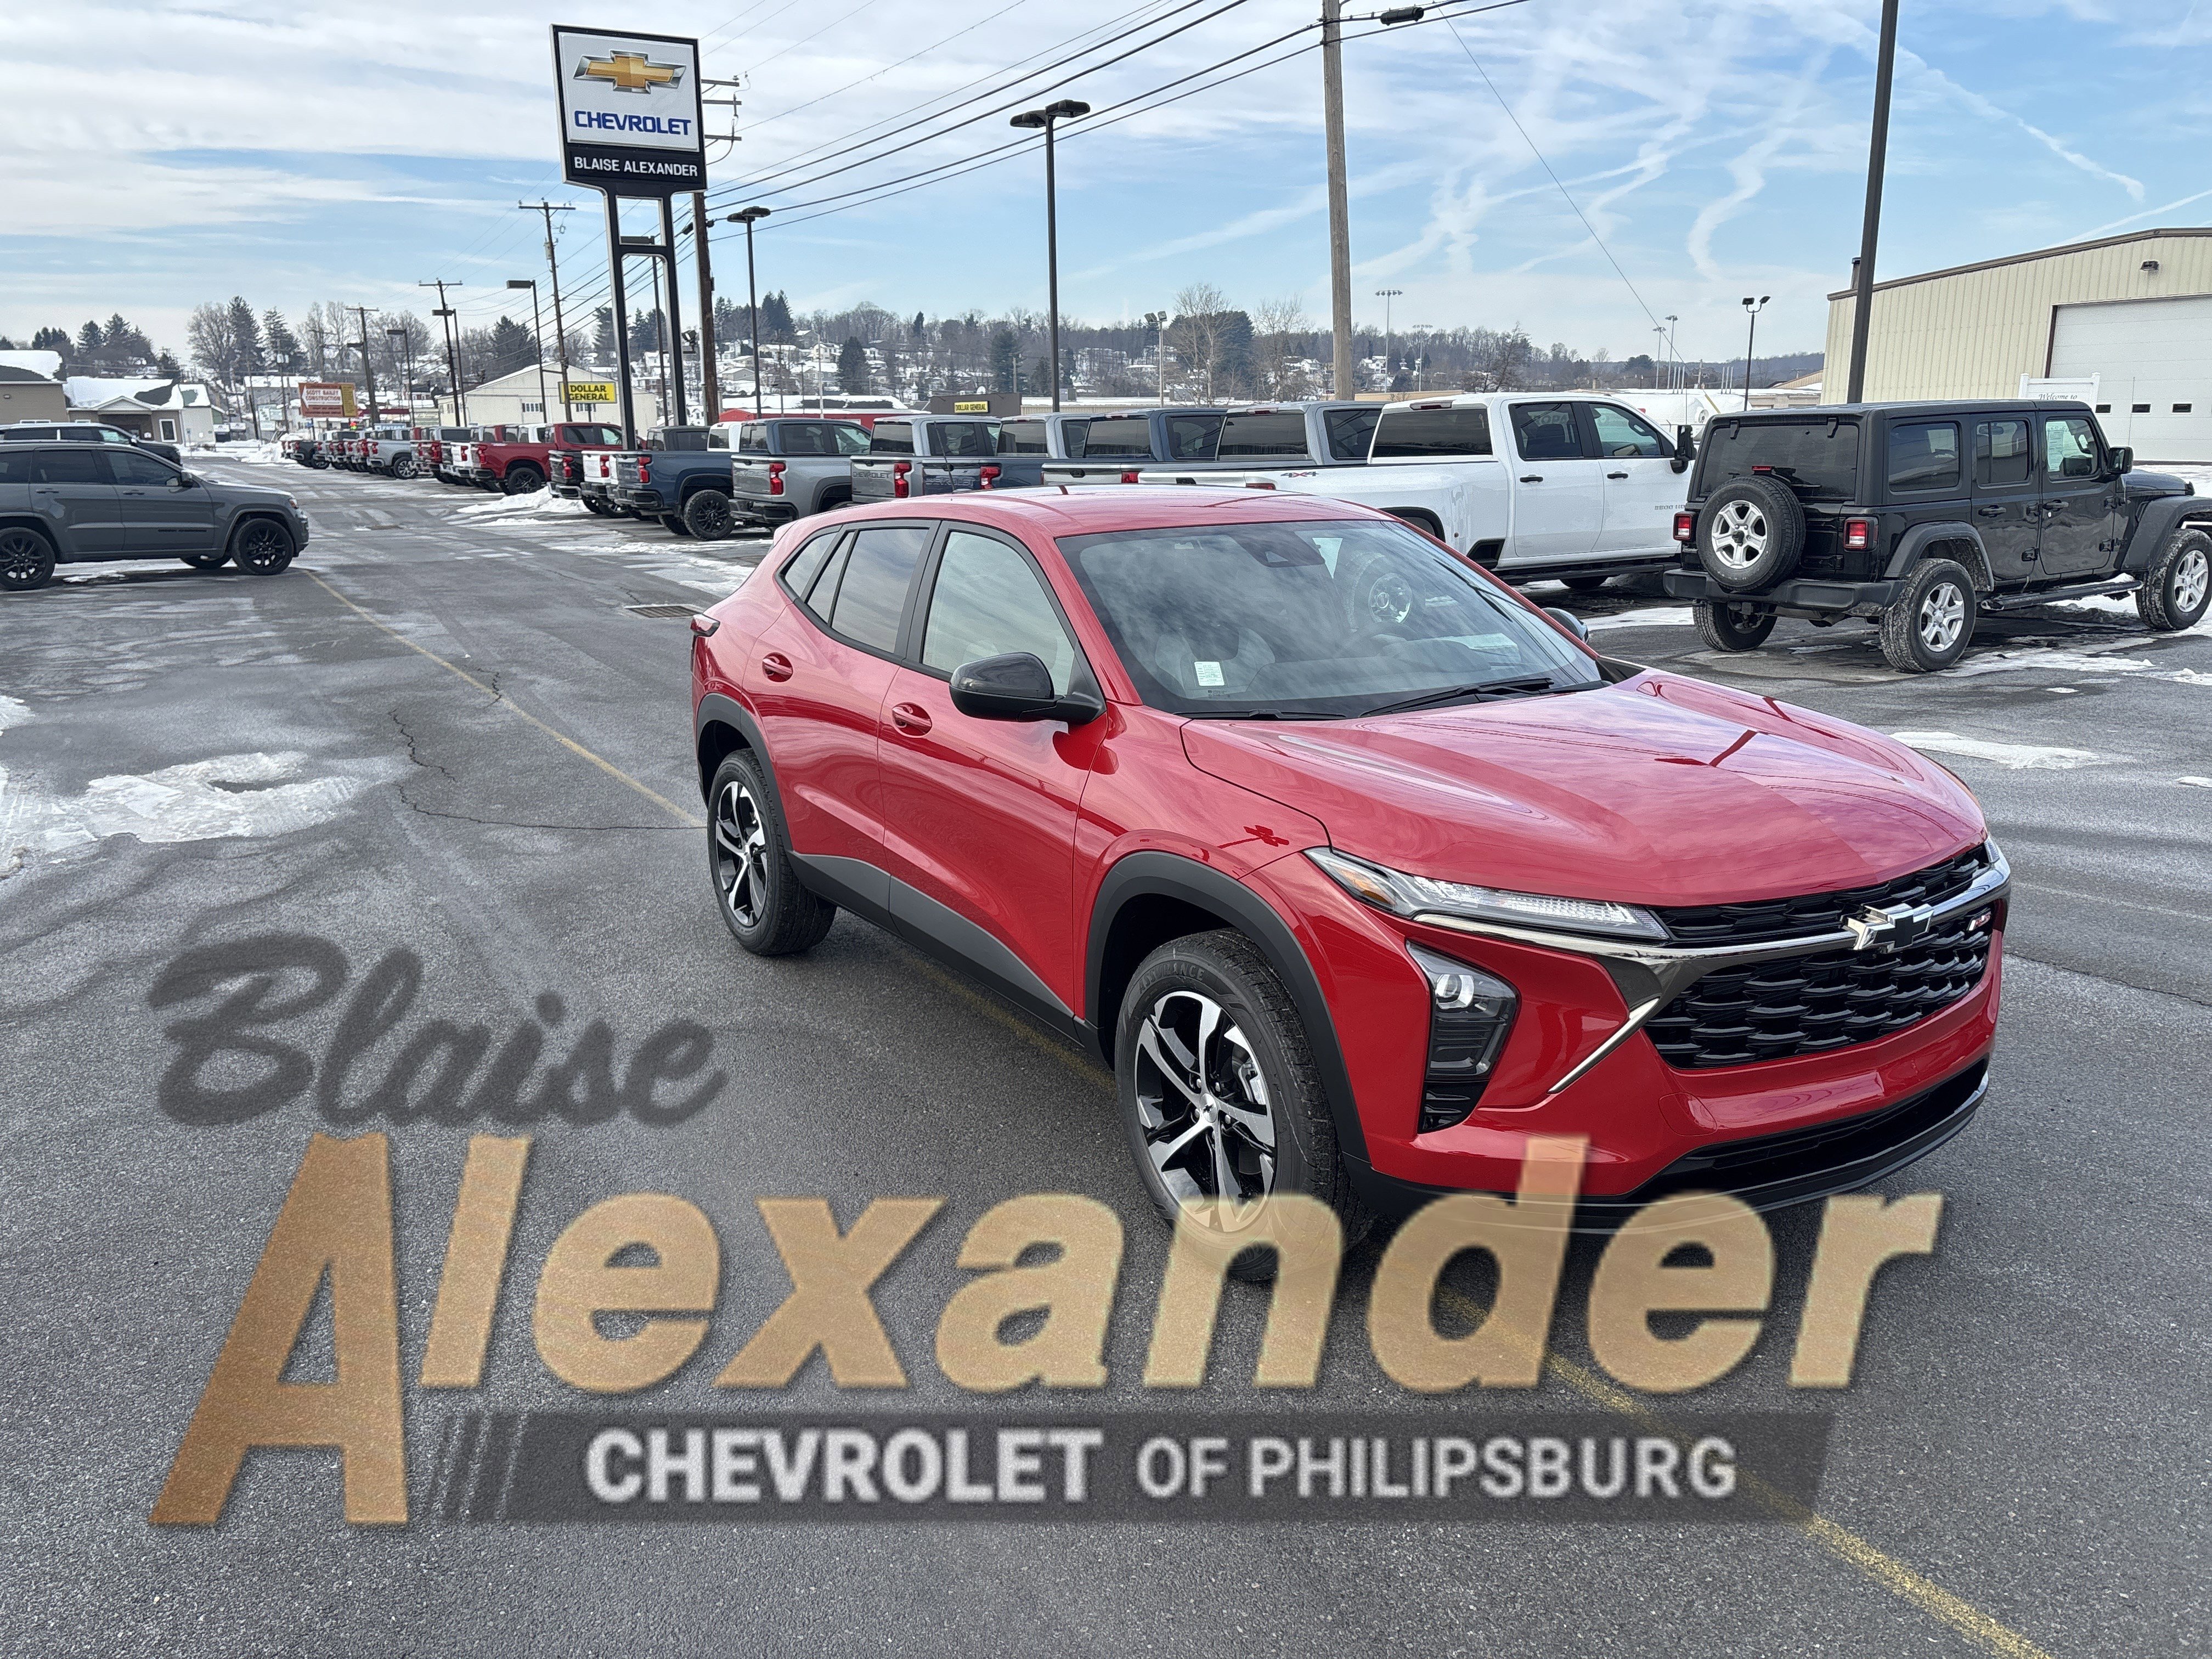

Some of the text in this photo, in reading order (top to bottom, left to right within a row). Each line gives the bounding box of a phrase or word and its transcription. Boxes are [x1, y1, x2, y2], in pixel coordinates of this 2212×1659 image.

[574, 110, 691, 136] CHEVROLET
[574, 156, 698, 177] BLAISE ALEXANDER
[1138, 963, 1205, 994] ASSURANCE
